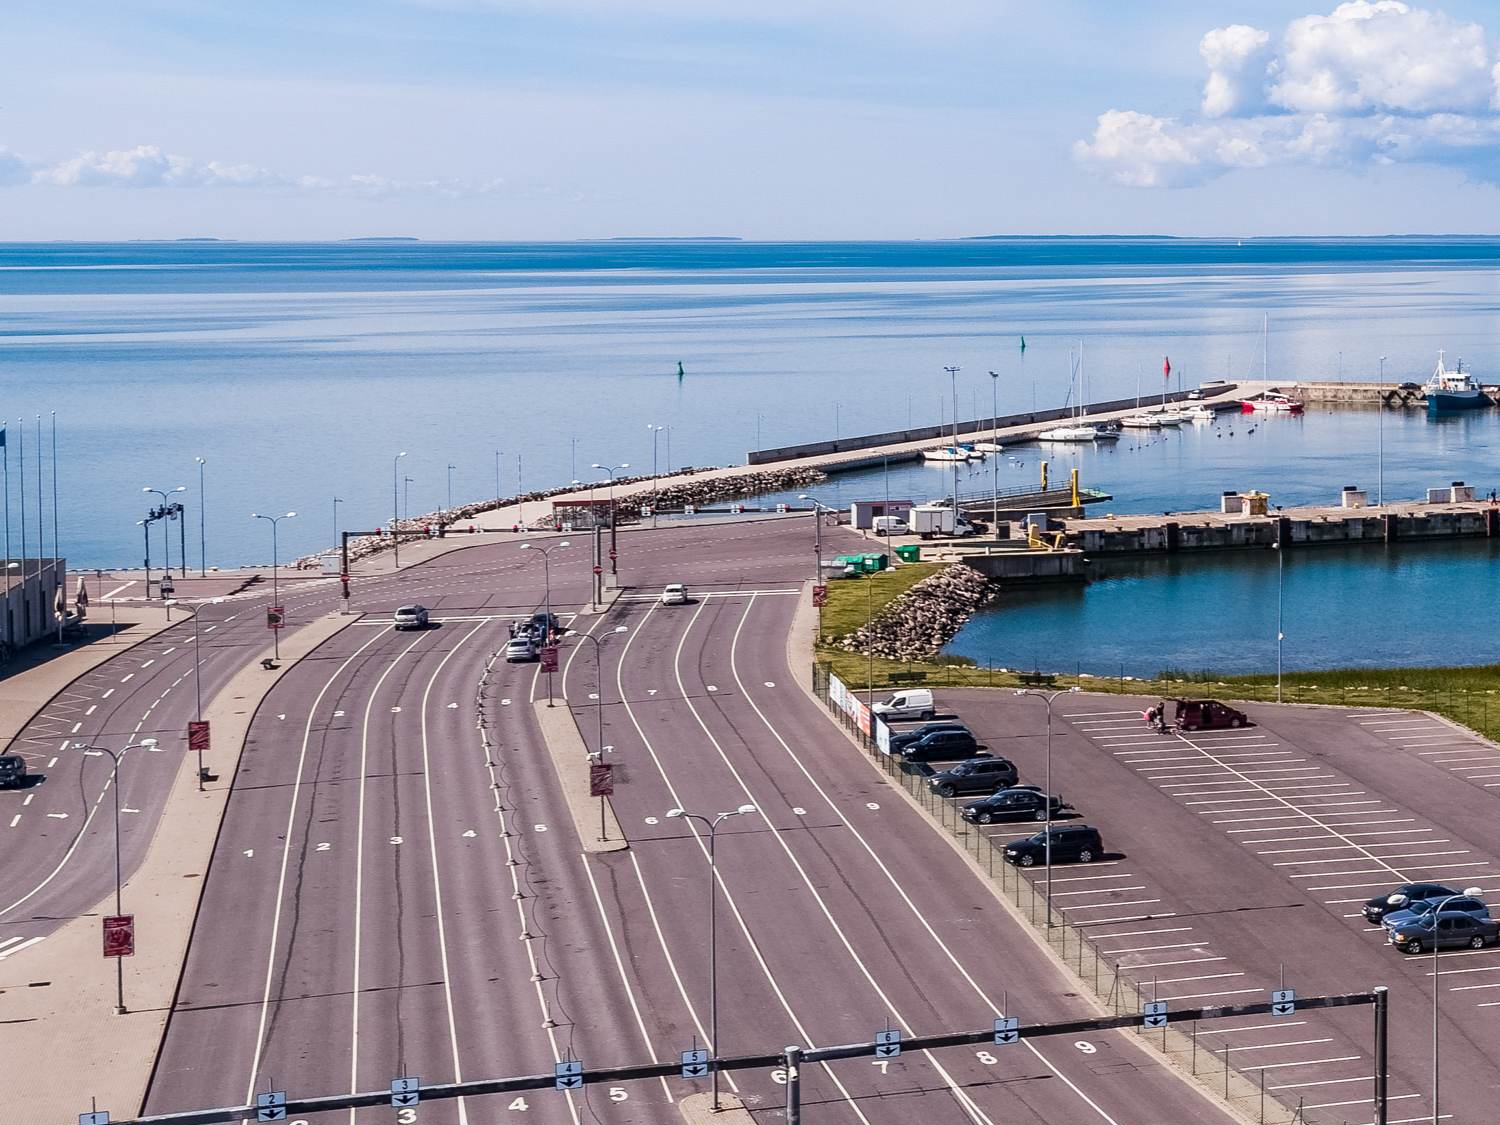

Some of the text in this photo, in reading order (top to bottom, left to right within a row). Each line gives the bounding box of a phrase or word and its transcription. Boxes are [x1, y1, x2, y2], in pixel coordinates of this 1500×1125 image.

[534, 824, 548, 832] 5
[462, 830, 477, 838] 4
[390, 837, 403, 845] 3
[316, 843, 331, 851] 2
[1280, 991, 1286, 1001] 9
[1152, 1004, 1158, 1012] 8
[1003, 1020, 1009, 1029] 7
[885, 1032, 891, 1041] 6
[1074, 1041, 1097, 1054] 9
[692, 1052, 698, 1061] 5
[976, 1050, 997, 1065] 8
[566, 1064, 572, 1073] 4
[872, 1061, 889, 1074] 7
[770, 1069, 788, 1084] 6
[402, 1080, 408, 1089] 3
[268, 1095, 275, 1104] 2
[609, 1088, 628, 1104] 5
[508, 1097, 528, 1112] 4
[91, 1115, 96, 1124] 1
[398, 1108, 416, 1124] 3
